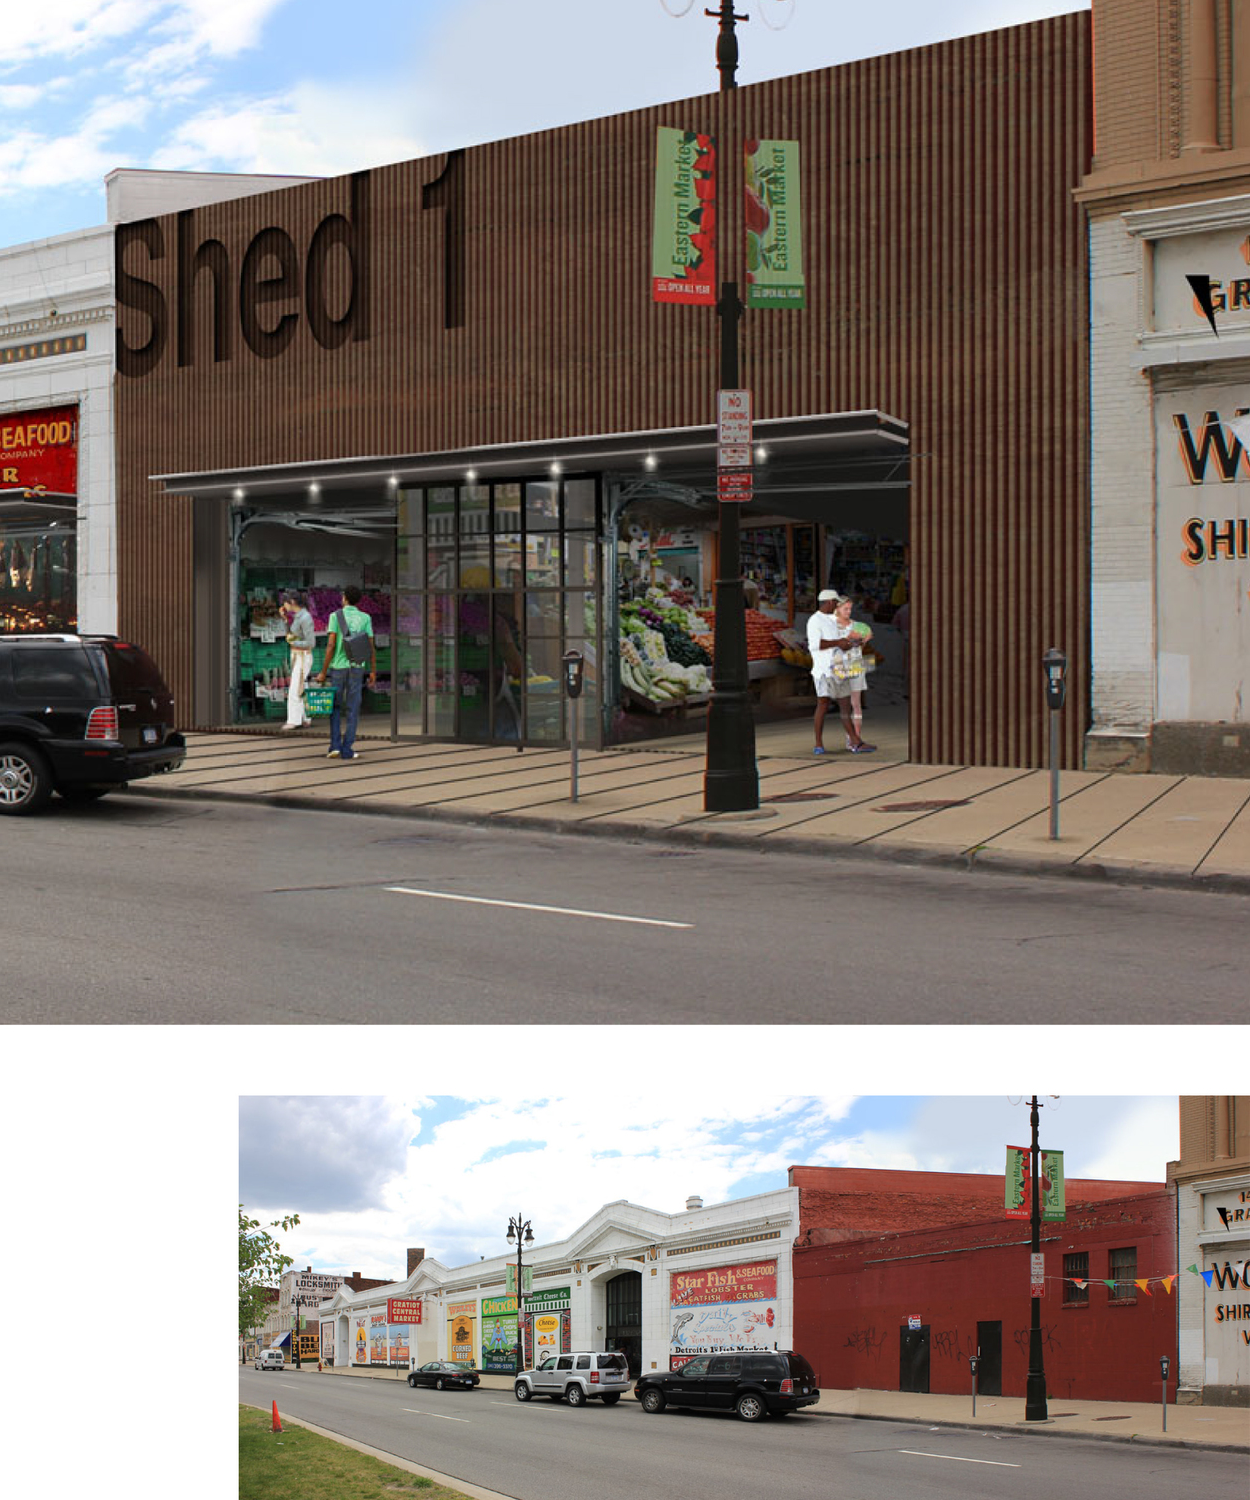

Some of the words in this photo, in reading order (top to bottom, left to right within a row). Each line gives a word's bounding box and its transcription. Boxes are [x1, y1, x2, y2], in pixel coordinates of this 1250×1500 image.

[674, 139, 691, 198] Market
[773, 148, 787, 205] Market
[672, 203, 689, 265] Eastern
[773, 210, 787, 271] Eastern
[115, 169, 370, 378] Shed
[422, 149, 466, 329] 1
[728, 397, 742, 407] NO
[1172, 406, 1250, 486] W
[677, 1275, 705, 1290] Star
[707, 1270, 737, 1287] Fish
[689, 1294, 721, 1303] CATFISH
[736, 1290, 765, 1300] CRABS
[705, 1284, 755, 1294] LOBSTER
[483, 1297, 518, 1315] CHICKEN
[675, 1346, 707, 1354] Detroit's
